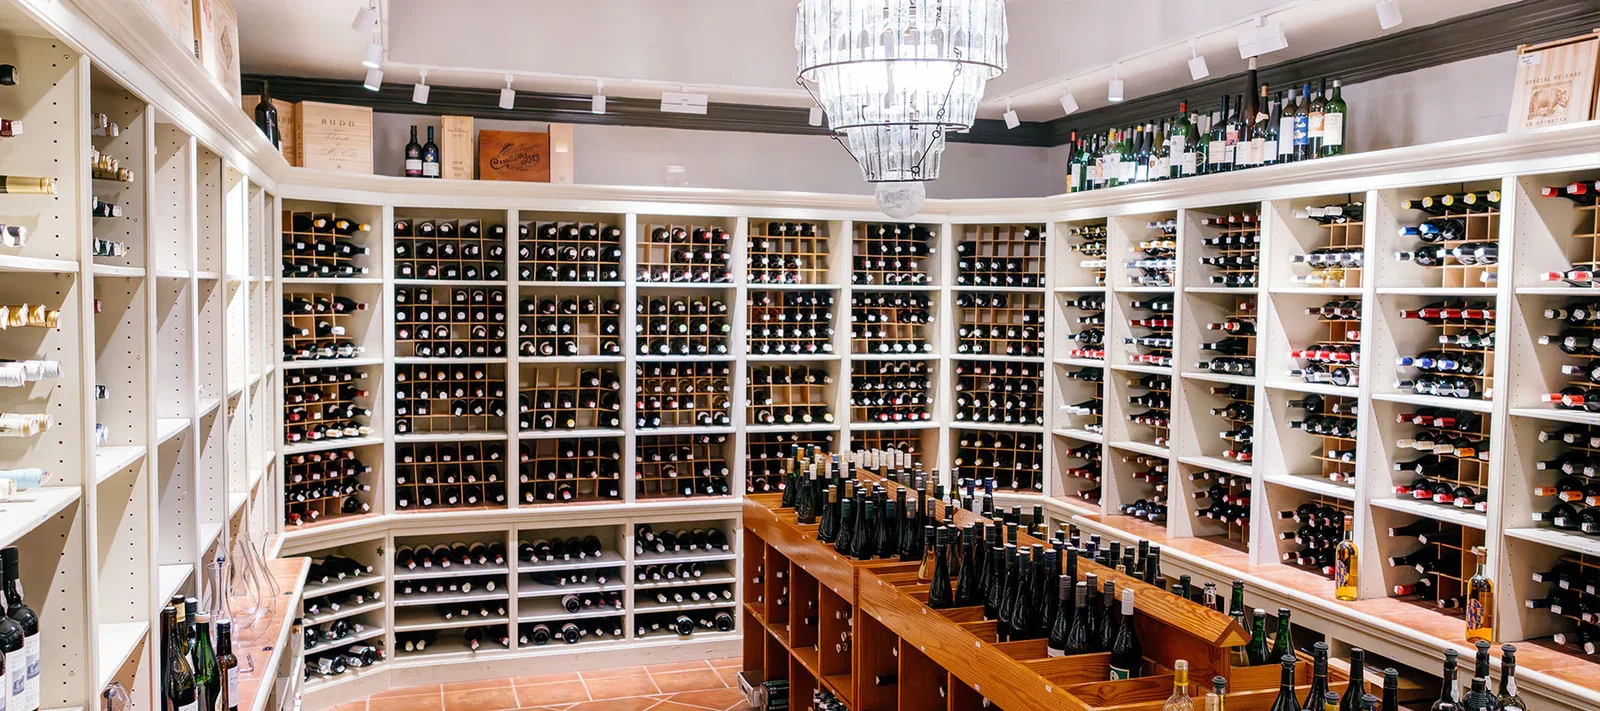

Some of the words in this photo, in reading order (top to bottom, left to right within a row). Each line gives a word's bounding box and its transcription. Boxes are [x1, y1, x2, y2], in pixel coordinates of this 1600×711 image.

[1525, 77, 1551, 86] SPECIAL
[1553, 71, 1582, 80] RELEASE
[321, 118, 355, 127] RUDD
[1536, 117, 1567, 126] SPINETTA
